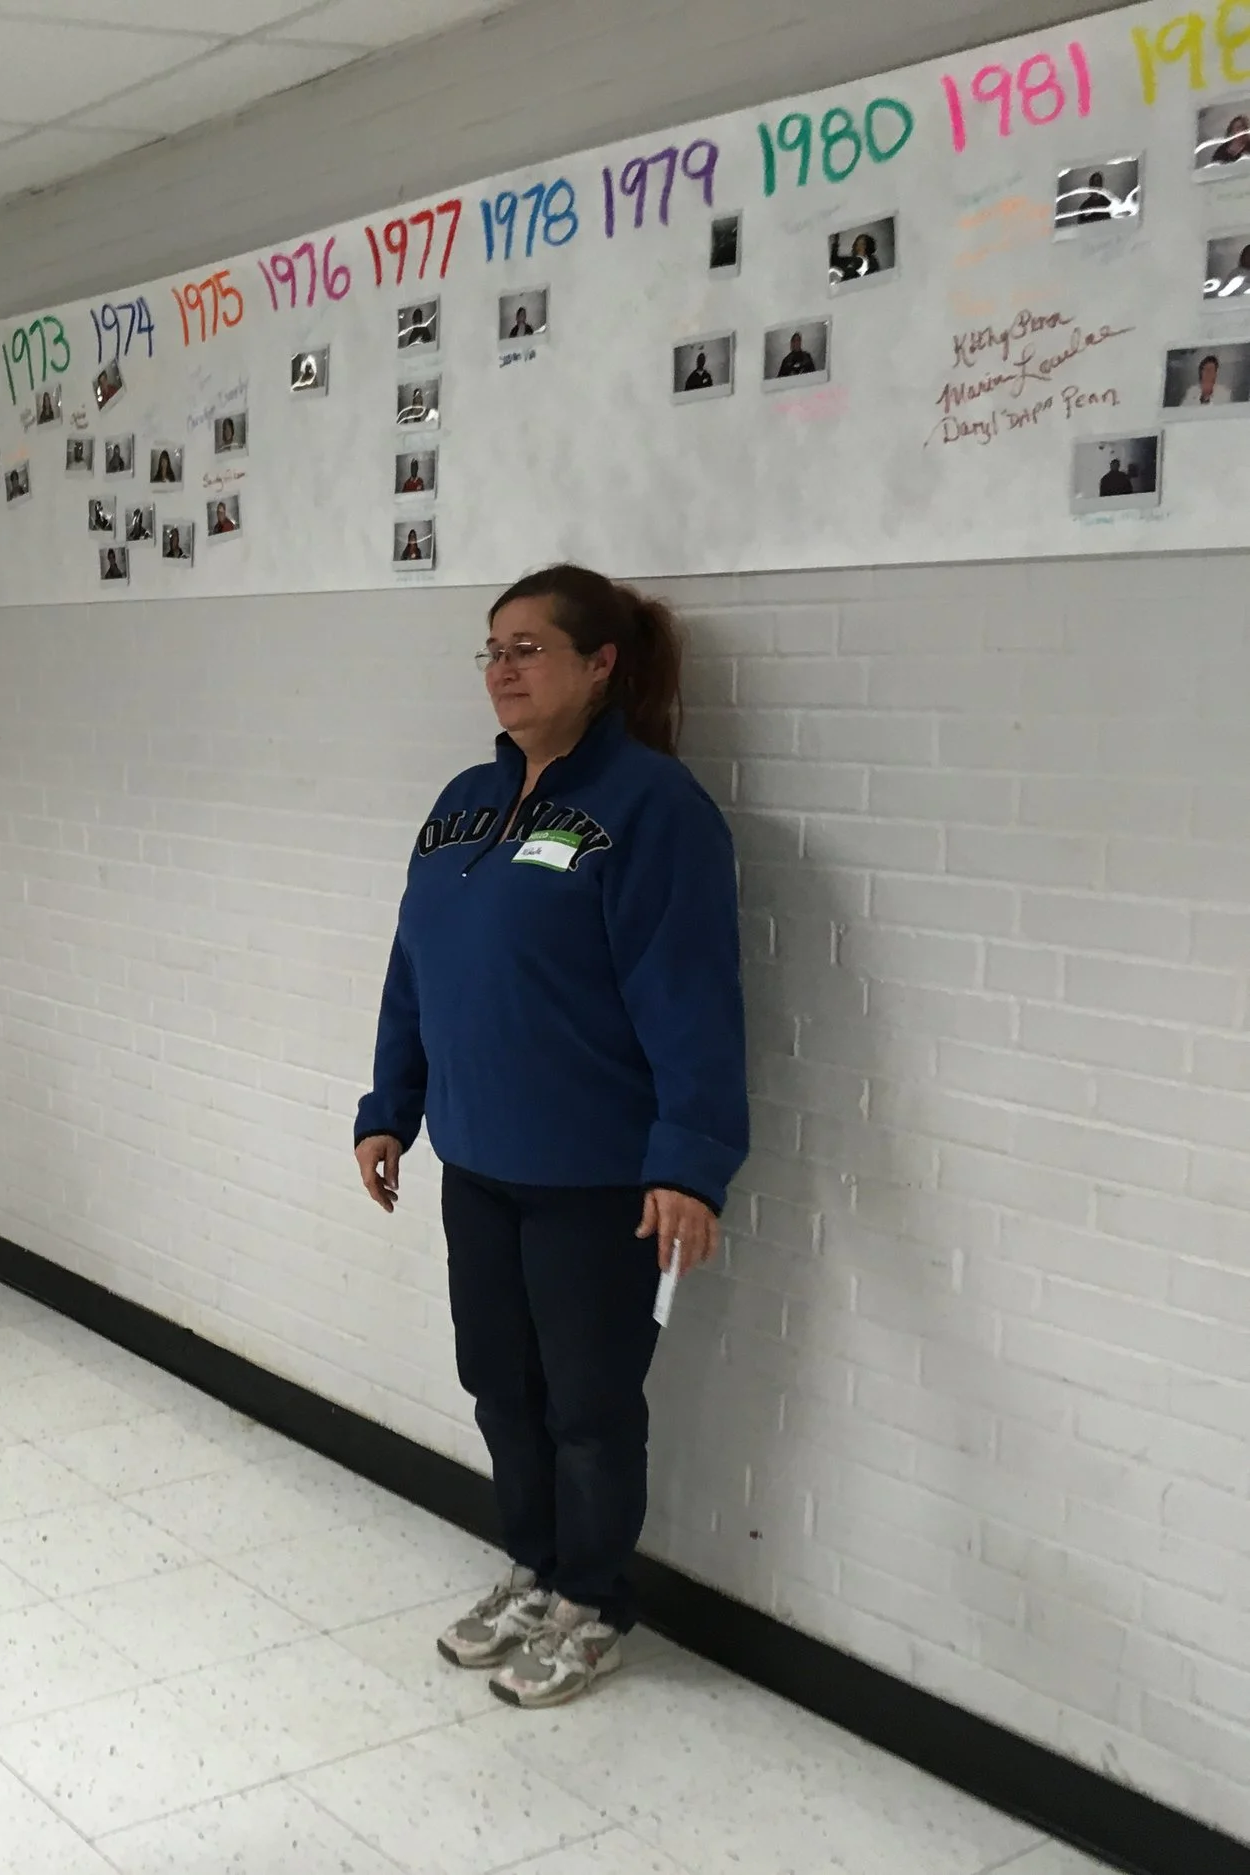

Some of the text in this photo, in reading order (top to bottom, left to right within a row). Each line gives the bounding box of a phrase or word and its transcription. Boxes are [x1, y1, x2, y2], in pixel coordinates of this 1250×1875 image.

[2, 315, 70, 406] 1973
[90, 296, 154, 363] 1974
[171, 269, 244, 347] 1975
[257, 237, 351, 312] 1976
[364, 199, 463, 287] 1977
[481, 178, 579, 263] 1978
[602, 139, 719, 238] 1979
[758, 98, 914, 197] 1980
[940, 41, 1092, 153] 1981
[417, 806, 501, 858] OLD
